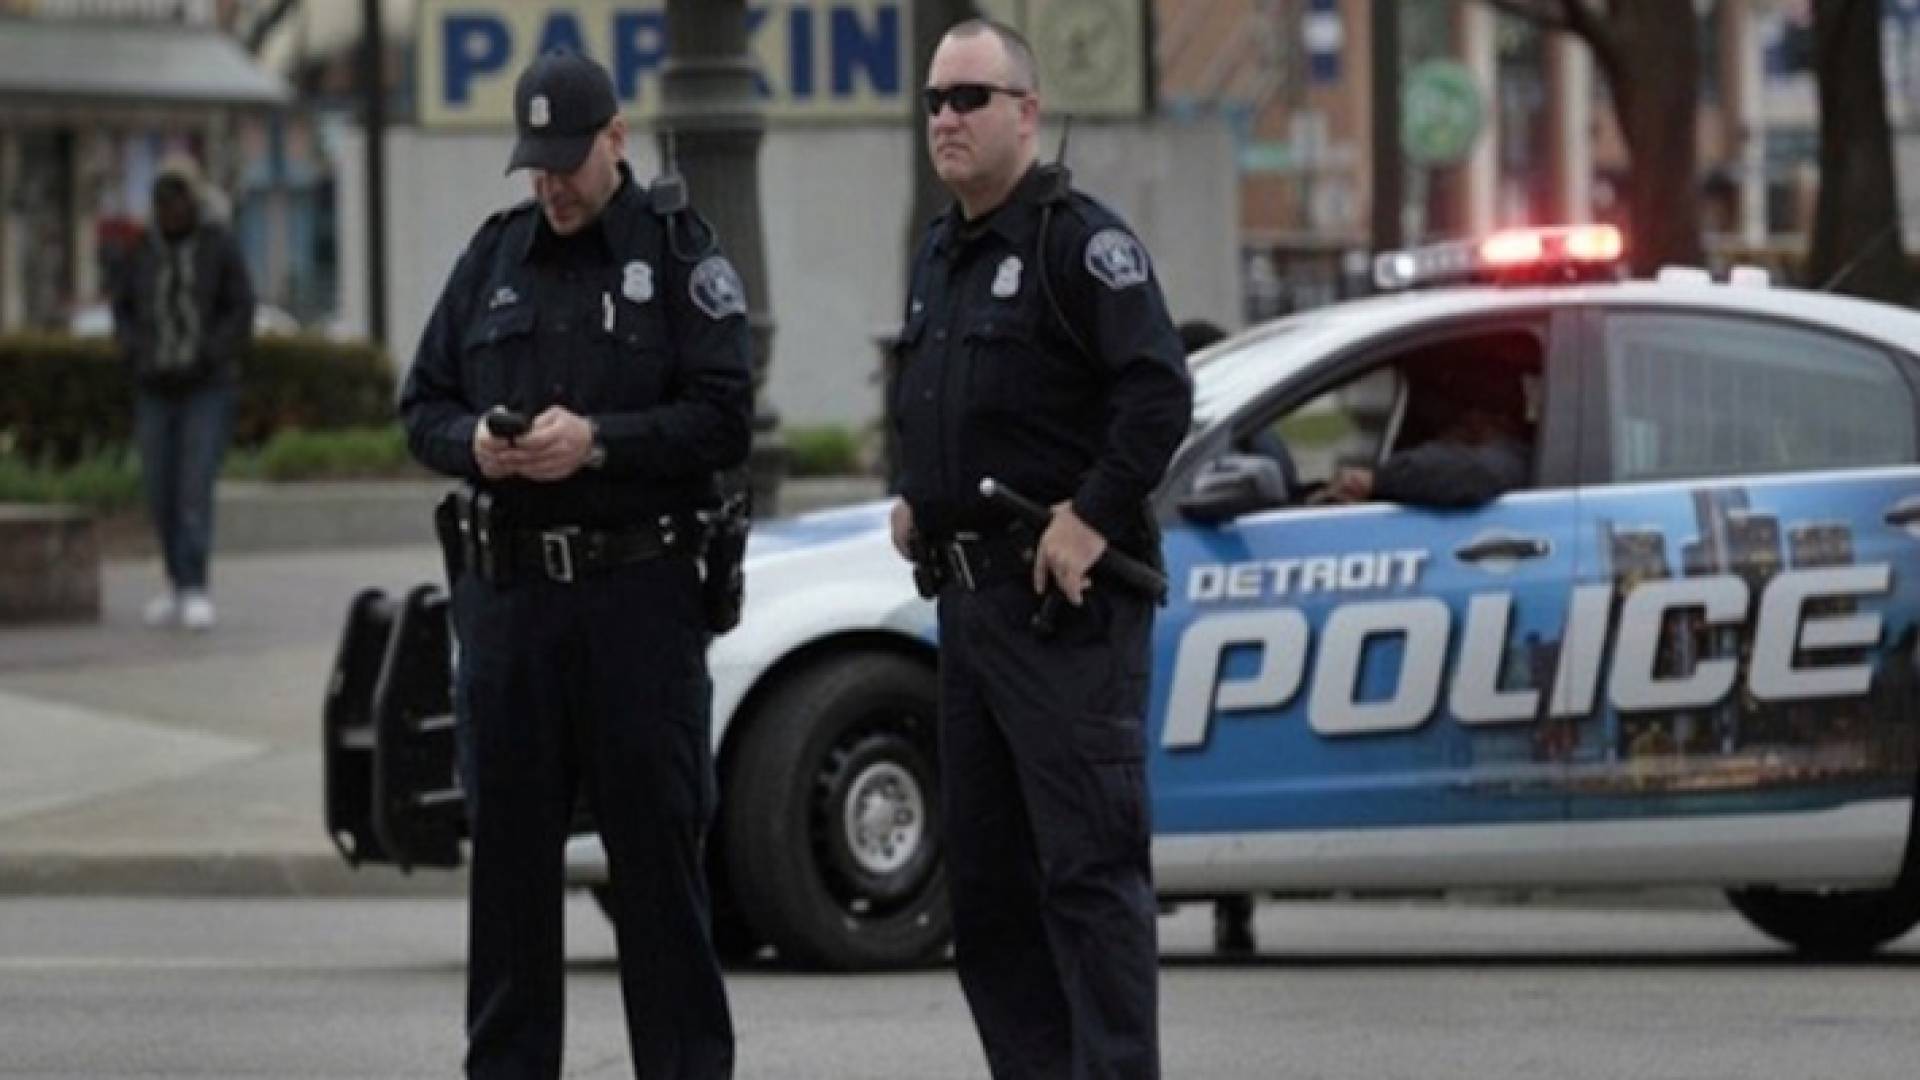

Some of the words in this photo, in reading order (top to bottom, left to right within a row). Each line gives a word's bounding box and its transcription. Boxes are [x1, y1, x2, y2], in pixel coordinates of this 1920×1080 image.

[443, 8, 900, 105] PRIN
[1189, 549, 1430, 601] DETROIT
[1161, 563, 1890, 749] POLICE
